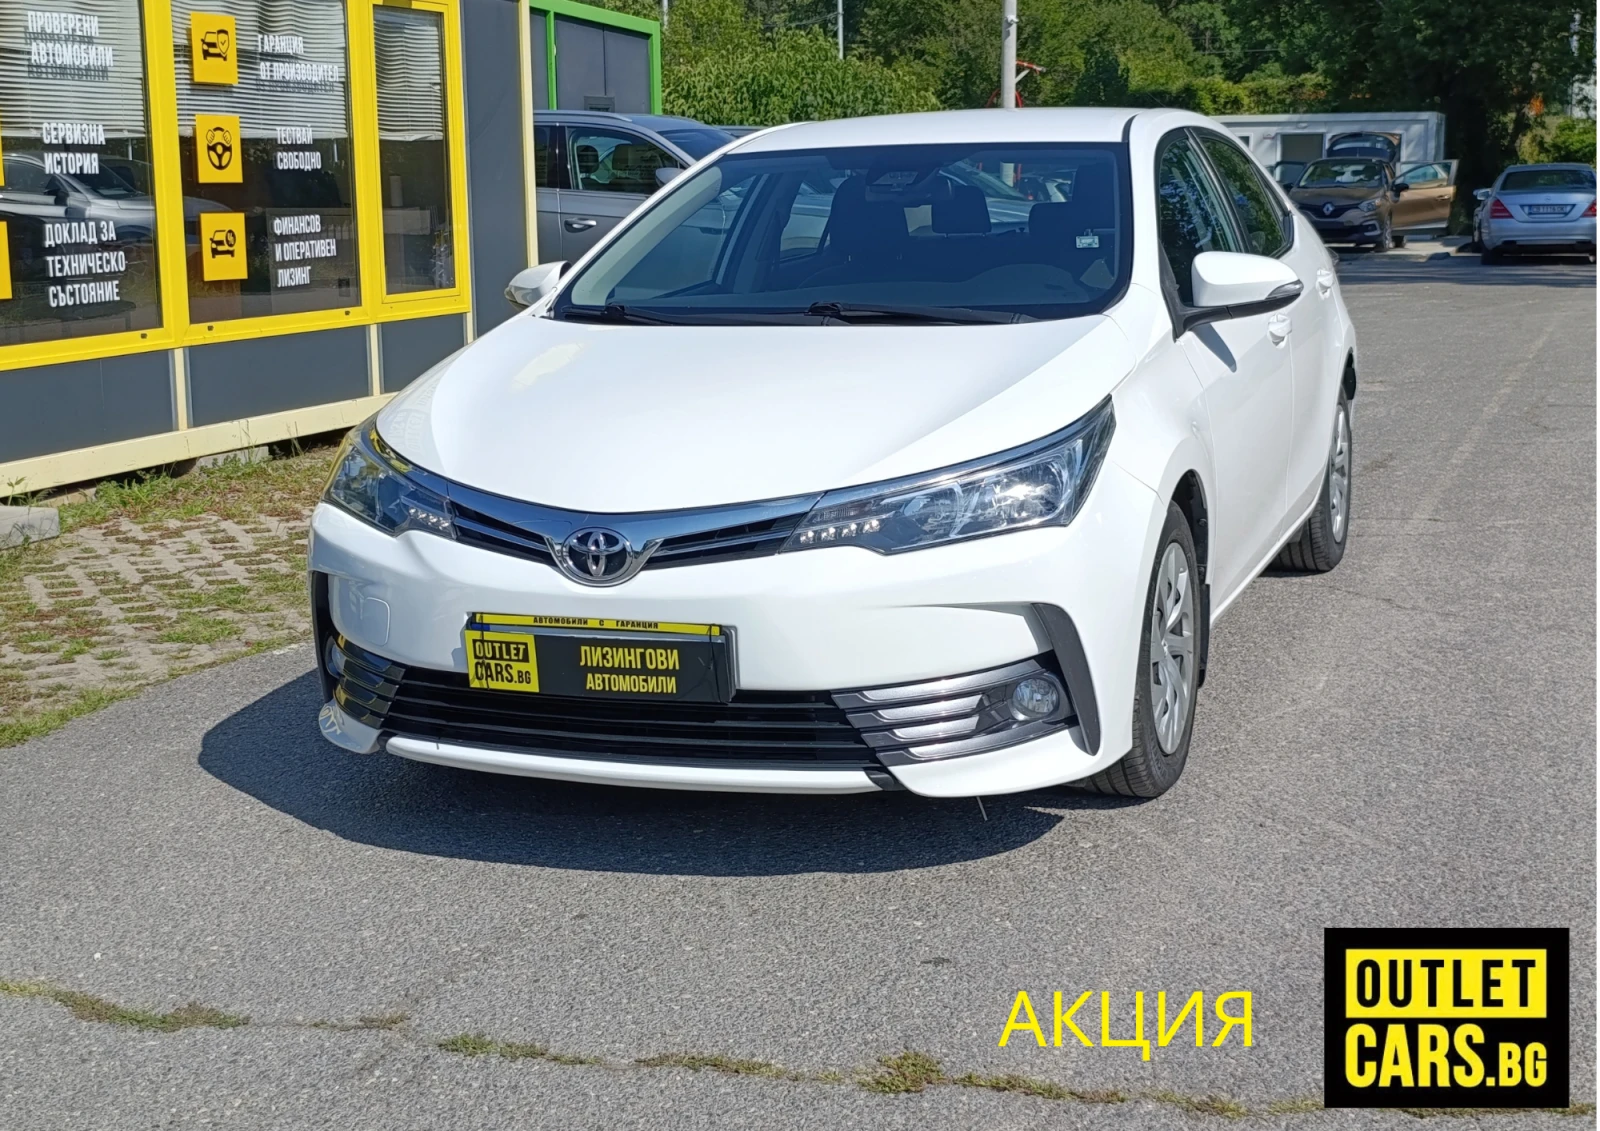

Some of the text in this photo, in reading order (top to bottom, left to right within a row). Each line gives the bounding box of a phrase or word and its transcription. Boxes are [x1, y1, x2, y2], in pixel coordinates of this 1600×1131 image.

[27, 10, 99, 37] ПРОВЕРЕНИ
[31, 41, 114, 67] АВТОМОБИЛИ
[258, 34, 304, 55] ГАРАНЦИЯ
[260, 62, 339, 82] ОТ ПРОИЗВОДИТЕЛ
[42, 122, 106, 145] СЕРВИЗНА
[276, 125, 313, 145] ТЕСТВАЙ
[44, 153, 100, 175] ИСТОРИЯ
[277, 151, 322, 171] СВОБОДНО
[44, 220, 117, 248] ДОКЛАД ЗА
[274, 214, 322, 236] ФИНАНСОВ
[275, 238, 337, 262] И ОПЕРАТИВЕН
[47, 251, 126, 278] ТЕХНИЧЕСКО
[277, 266, 312, 288] ЛИЗИНГ
[533, 616, 588, 626] АВТОМОБИЛИ
[616, 620, 659, 629] ГАРАНЦИЯ
[475, 641, 526, 660] OUTLET
[580, 645, 680, 670] ЛИЗИНГОВИ
[474, 661, 532, 685] CARS.BG
[586, 673, 677, 694] АВТОМОБИЛИ
